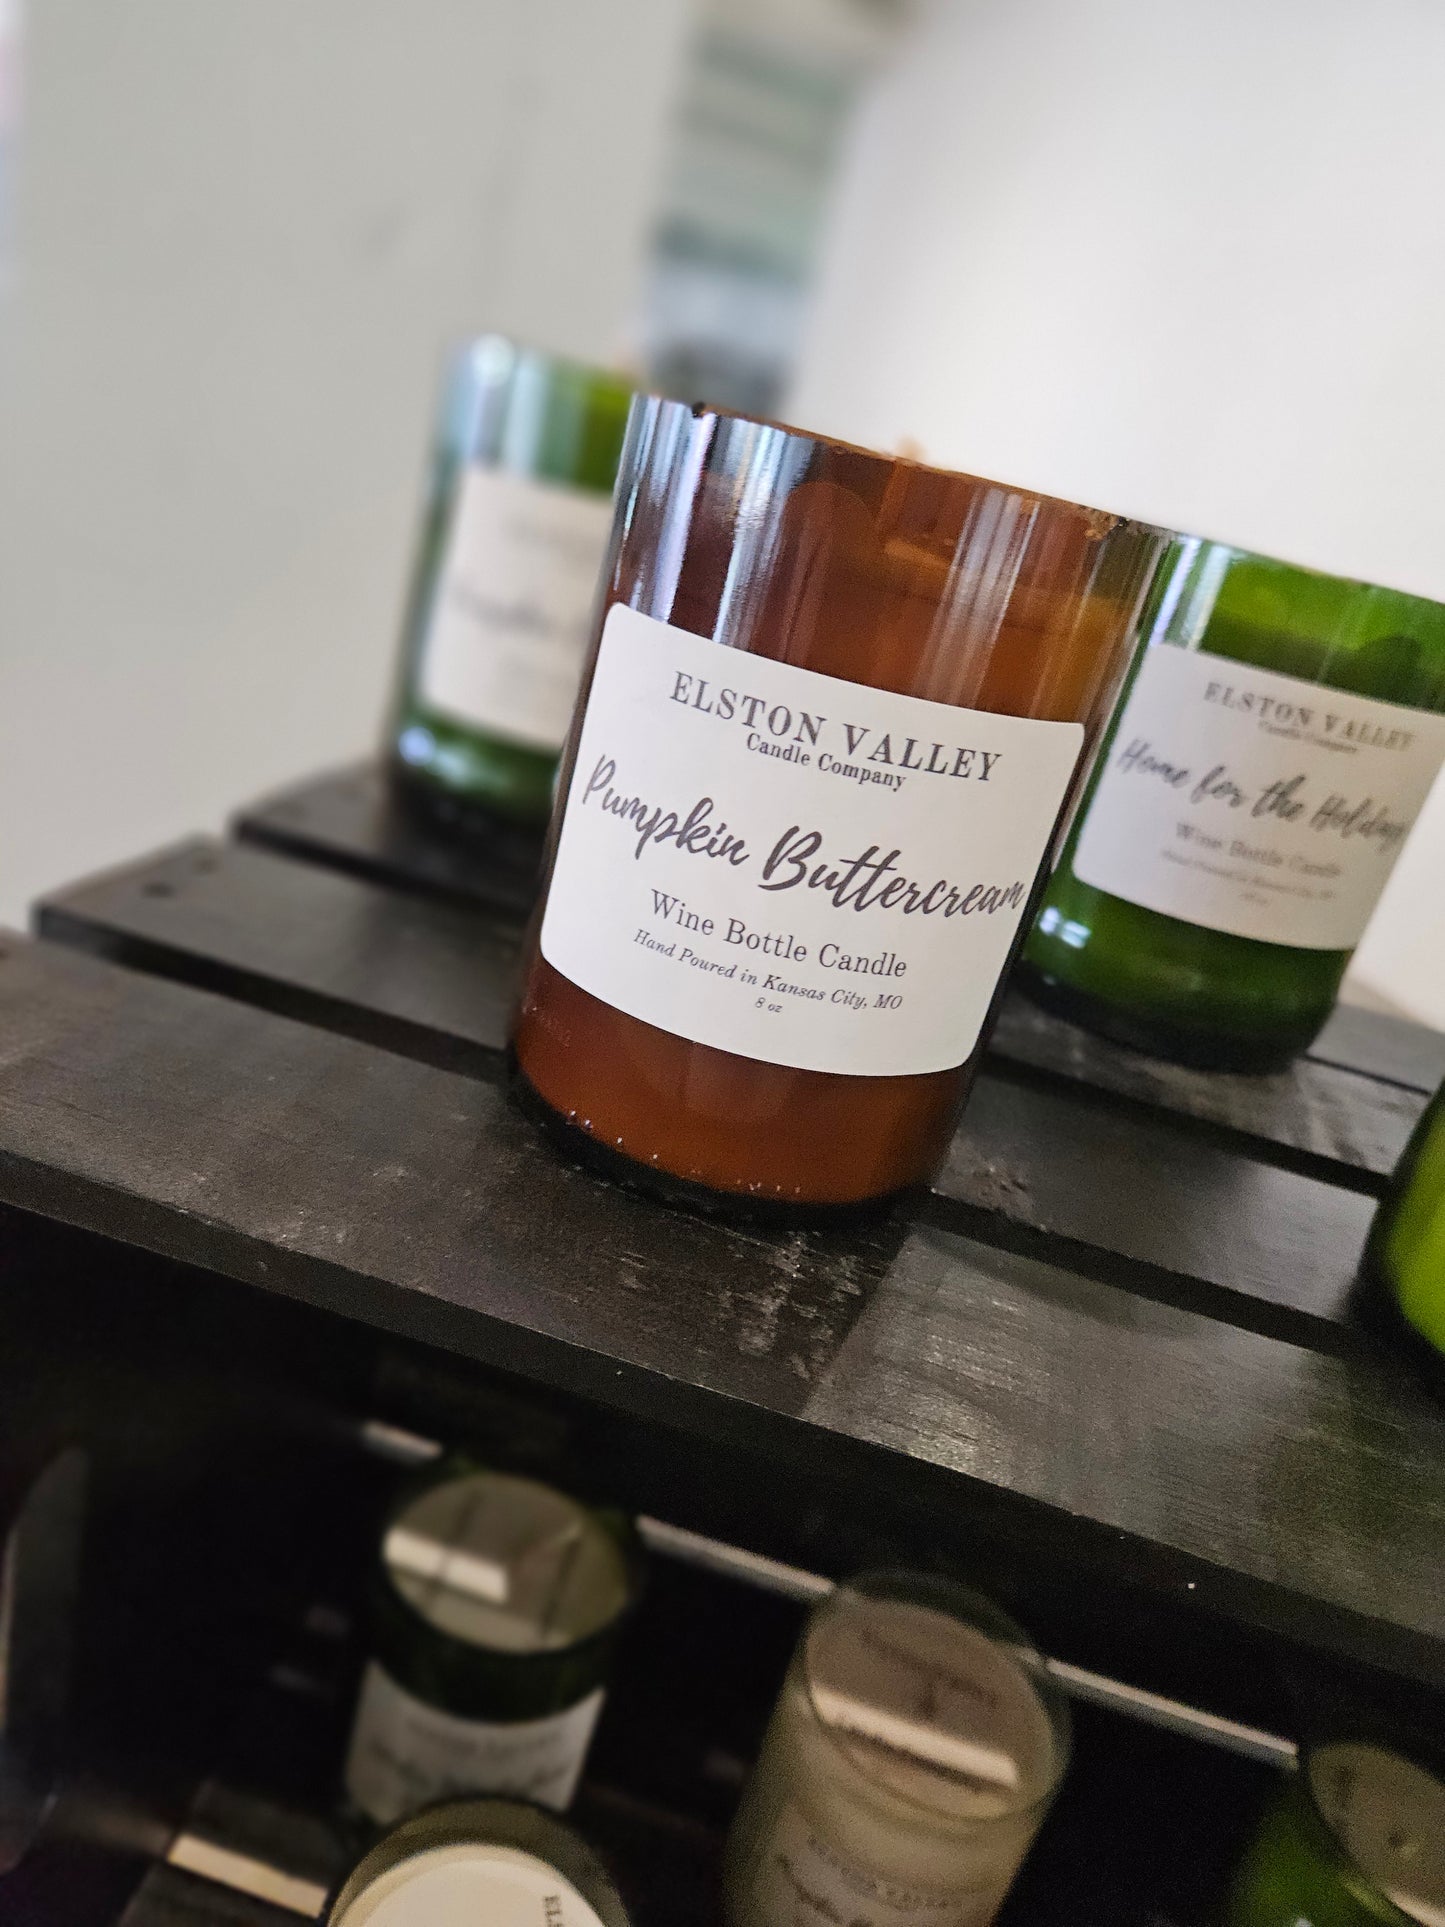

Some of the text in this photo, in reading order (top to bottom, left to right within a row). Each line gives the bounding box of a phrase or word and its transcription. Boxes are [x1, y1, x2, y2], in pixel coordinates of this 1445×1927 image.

[669, 671, 1002, 781] ELSTON VALLEY
[747, 732, 907, 792] Candle Company
[582, 754, 1026, 918] Pumpkin Buttercream
[634, 928, 903, 1010] Hand Poured in Kansas City, MO
[651, 888, 907, 977] Wine Bottle Candle
[755, 996, 783, 1013] 8 oz
